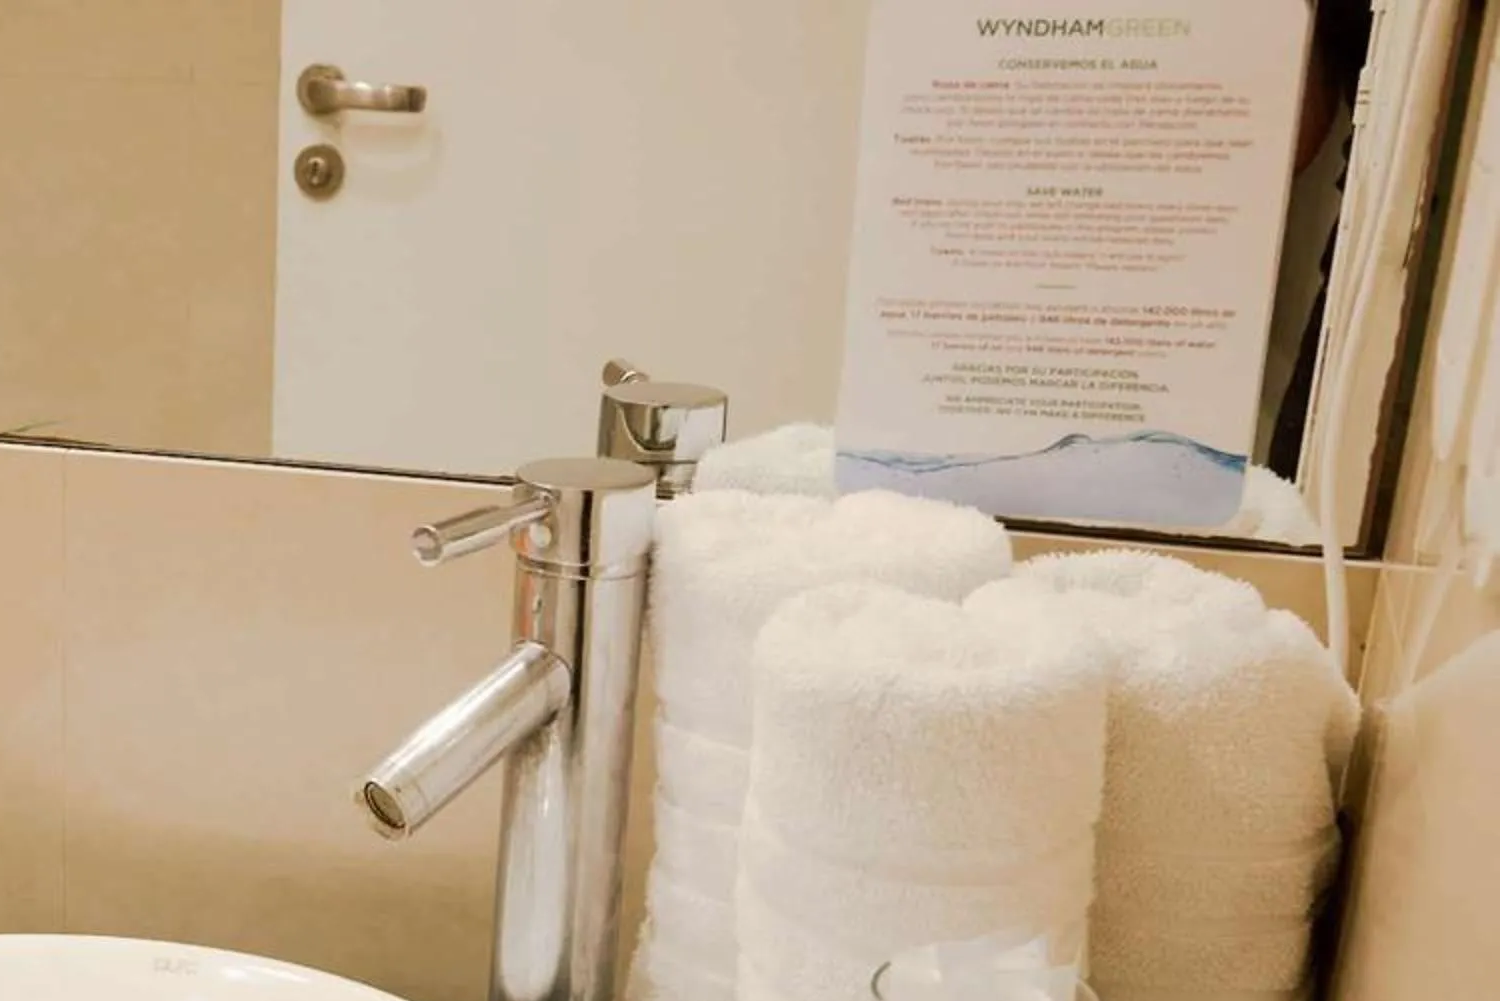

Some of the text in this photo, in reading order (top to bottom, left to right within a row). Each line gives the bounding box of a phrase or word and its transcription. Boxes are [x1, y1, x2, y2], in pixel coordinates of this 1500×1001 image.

[998, 58, 1158, 71] CONSERVEMOS EL AGUA
[1027, 187, 1104, 199] SAVE WATER
[952, 361, 1002, 374] GRACIAS
[1004, 364, 1028, 375] POR
[1032, 366, 1047, 375] SU
[970, 375, 1026, 387] PODEMOS
[1029, 378, 1078, 388] MARCAR
[1081, 380, 1095, 390] LA
